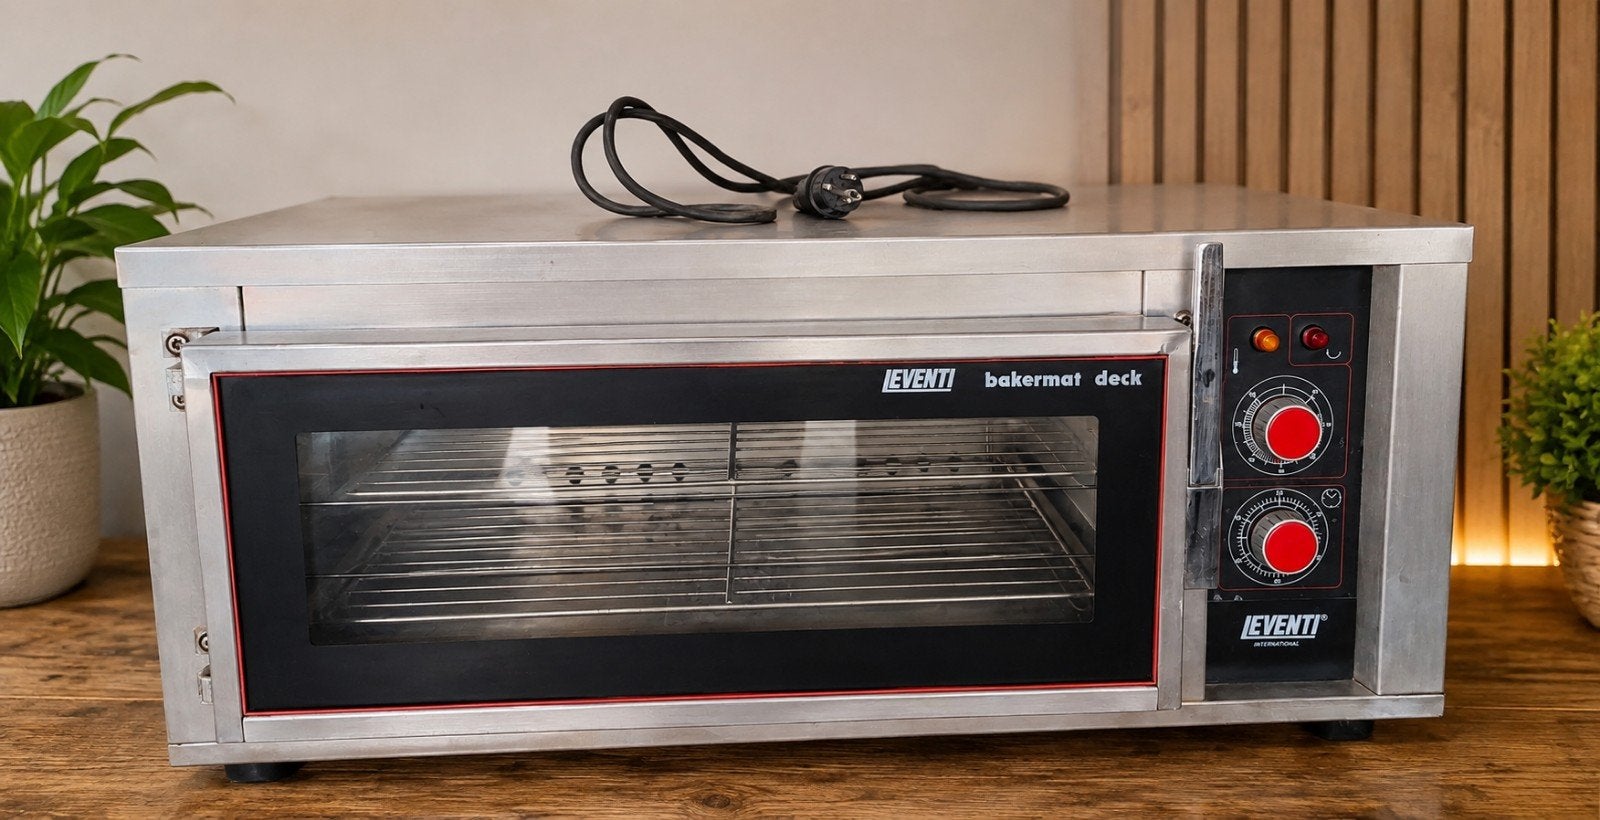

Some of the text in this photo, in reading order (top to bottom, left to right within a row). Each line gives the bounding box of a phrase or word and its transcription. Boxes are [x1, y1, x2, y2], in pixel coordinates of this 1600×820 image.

[882, 368, 956, 393] LEVENTI
[985, 370, 1142, 388] bakermat deck
